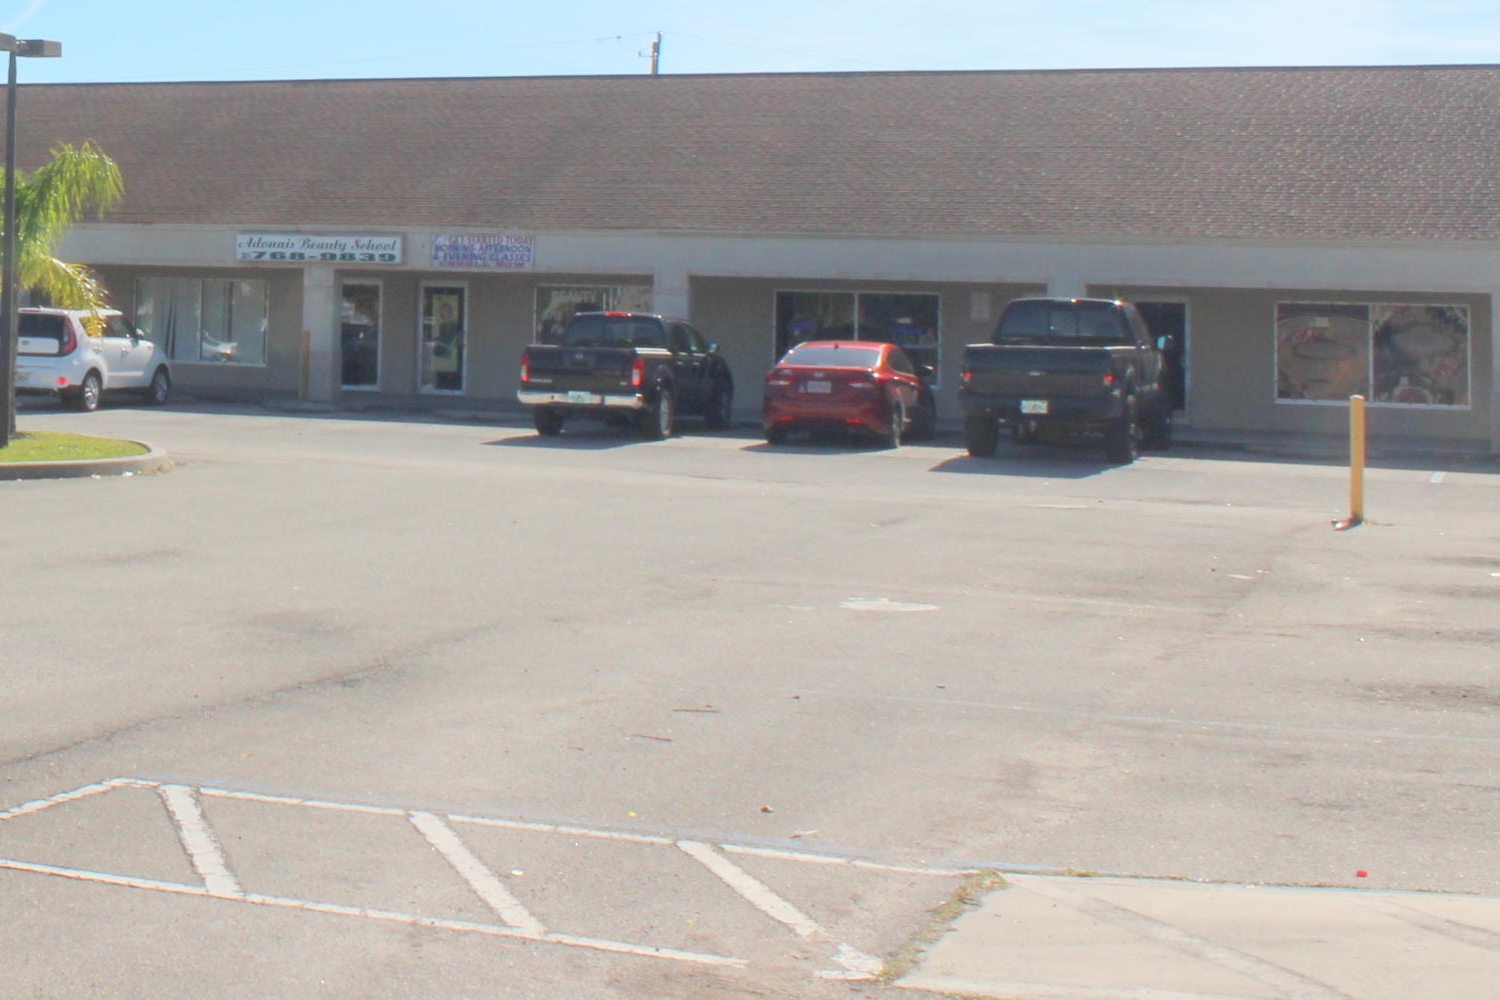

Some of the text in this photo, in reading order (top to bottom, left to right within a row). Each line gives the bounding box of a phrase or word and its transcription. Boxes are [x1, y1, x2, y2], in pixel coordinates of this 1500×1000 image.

[300, 236, 347, 251] Beauty
[350, 238, 397, 252] School
[252, 251, 396, 262] 768-9839
